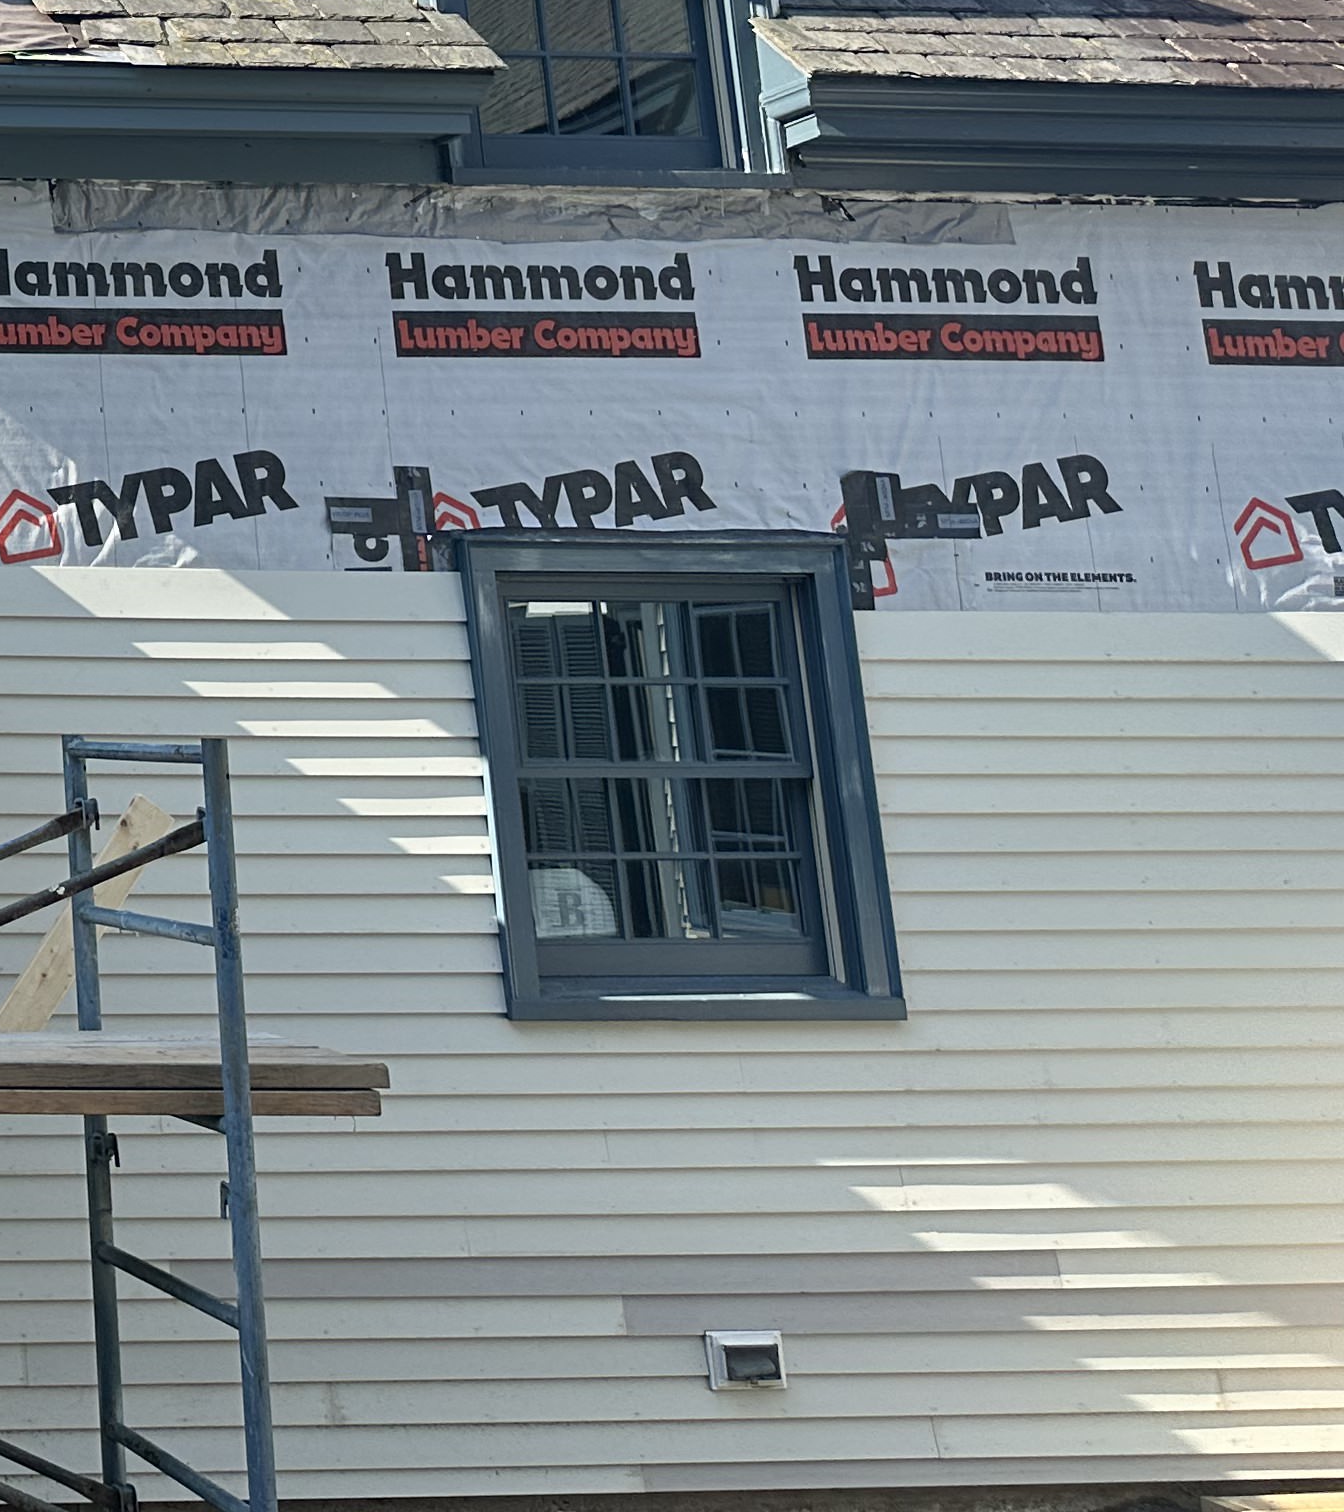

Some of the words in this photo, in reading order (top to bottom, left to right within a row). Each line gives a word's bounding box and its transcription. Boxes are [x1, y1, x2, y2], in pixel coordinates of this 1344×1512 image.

[385, 252, 695, 301] Hammond
[793, 255, 1098, 305] Hammond
[116, 316, 283, 354] Company
[398, 319, 525, 351] Lumber
[533, 319, 698, 357] Company
[807, 321, 932, 353] Lumber
[940, 322, 1102, 360] Company
[1208, 327, 1330, 360] Lumber
[47, 450, 300, 547] TYPAR
[470, 451, 717, 529] TYPAR
[985, 572, 1023, 582] BRING
[1025, 572, 1043, 582] ON
[1044, 572, 1069, 582] THE
[1070, 573, 1137, 583] ELEMENTS.
